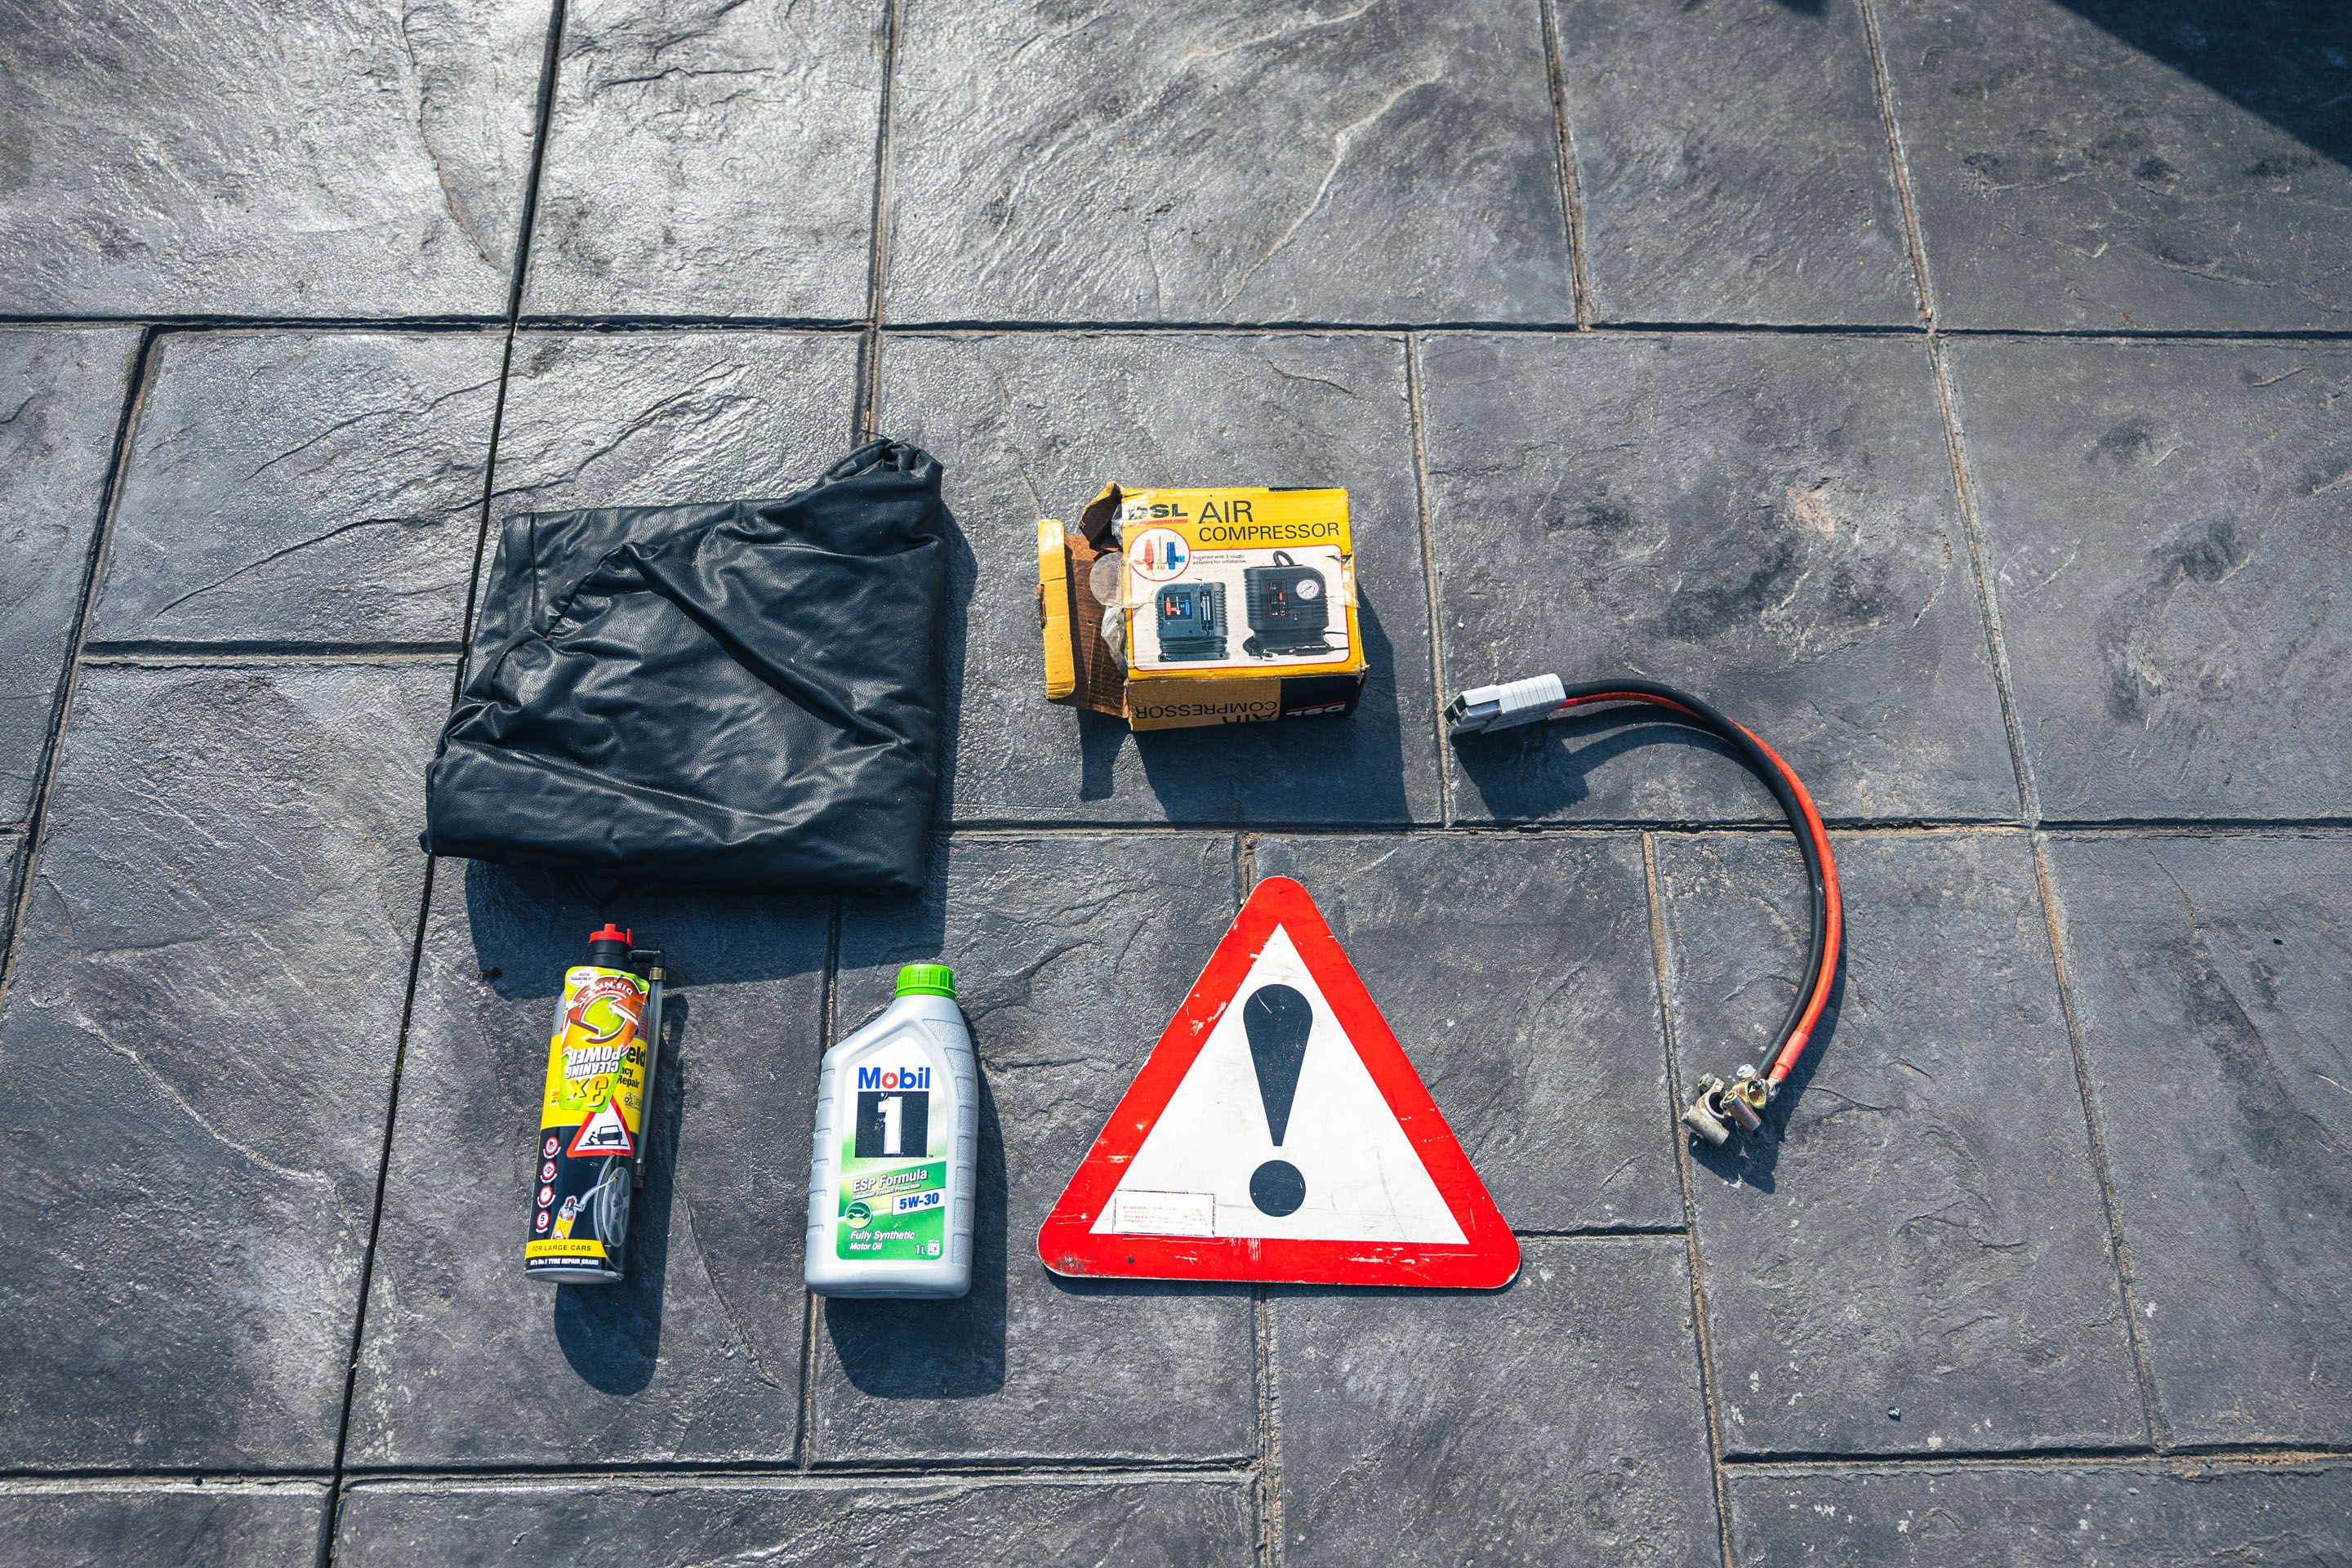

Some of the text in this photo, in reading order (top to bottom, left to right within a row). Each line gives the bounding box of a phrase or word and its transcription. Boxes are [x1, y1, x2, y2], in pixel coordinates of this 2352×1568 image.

[1129, 504, 1188, 520] DSL
[1198, 500, 1253, 523] AIR
[1199, 522, 1339, 541] COMPRESSOR
[1135, 701, 1278, 719] COMPRESSOR
[1285, 704, 1346, 717] DSL
[568, 1045, 623, 1066] POWER
[565, 1060, 619, 1079] CLEANING
[858, 1067, 930, 1089] Mobil
[617, 1076, 639, 1089] Repair
[877, 1096, 903, 1154] 1
[853, 1168, 929, 1192] ESP Formula
[852, 1183, 920, 1200] Emission System Protection
[899, 1192, 940, 1210] 5W-30
[850, 1230, 915, 1241] Fully Synthetic
[849, 1241, 882, 1250] Motor Oil
